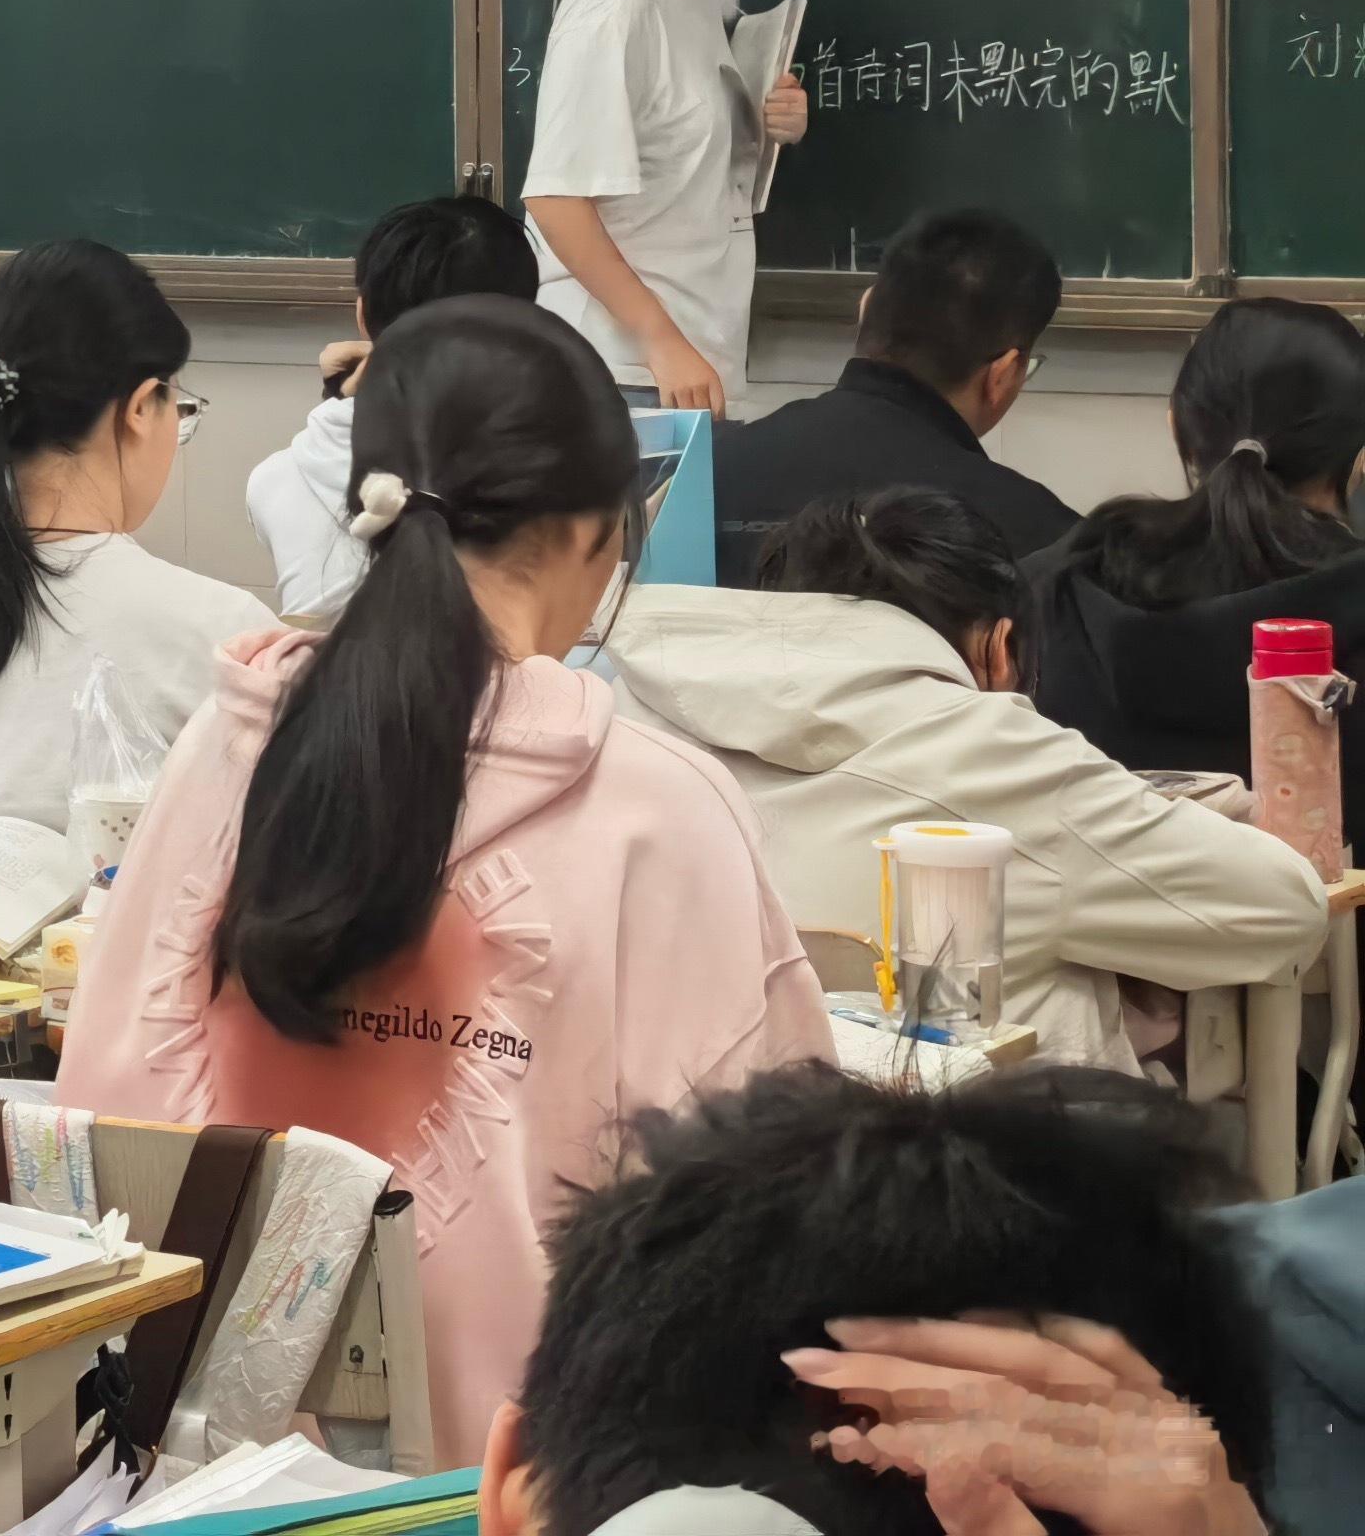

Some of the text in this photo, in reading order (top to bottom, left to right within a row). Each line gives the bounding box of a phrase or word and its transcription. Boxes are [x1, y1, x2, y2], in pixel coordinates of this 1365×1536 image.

[1285, 13, 1365, 79] 刘
[792, 38, 1186, 126] 首诗词未默完的默
[340, 1004, 533, 1062] negildo Zegna
